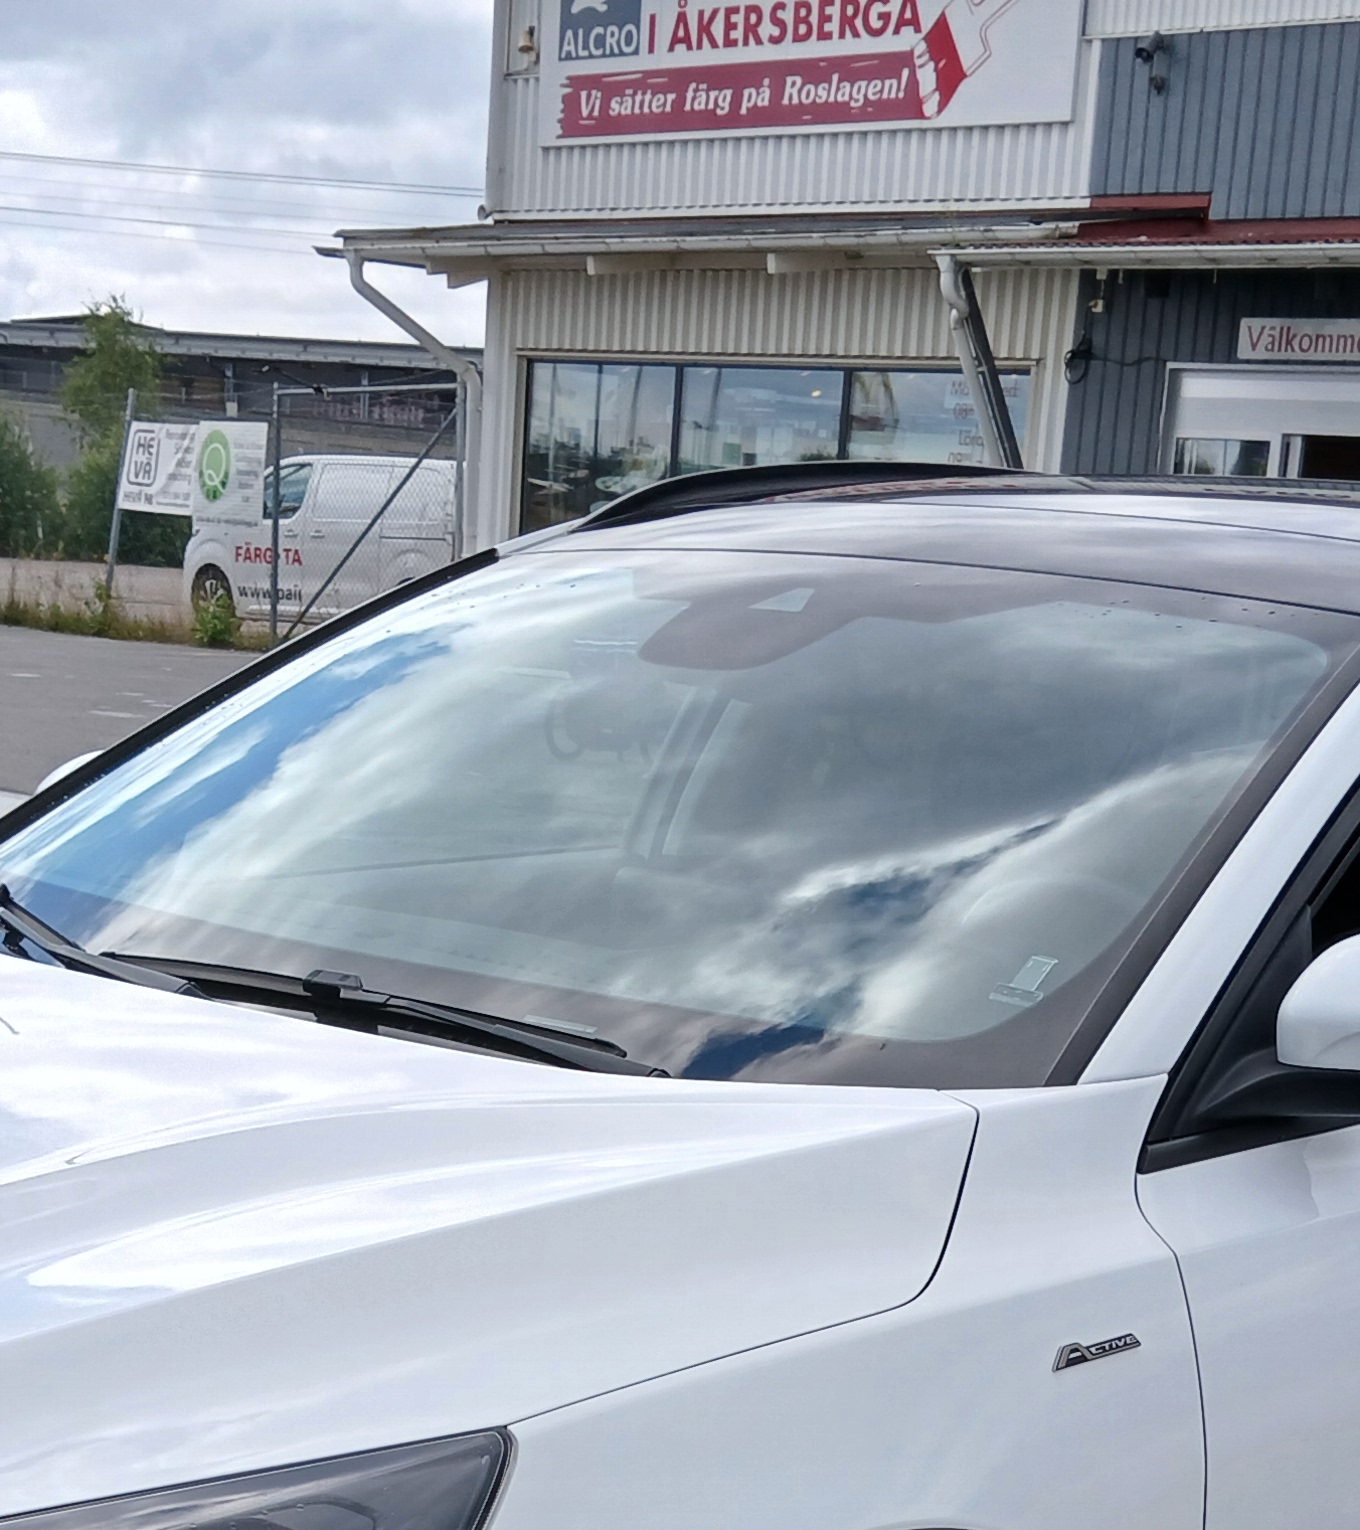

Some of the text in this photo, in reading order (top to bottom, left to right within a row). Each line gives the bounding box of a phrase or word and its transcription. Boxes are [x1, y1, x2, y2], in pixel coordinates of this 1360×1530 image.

[560, 23, 639, 59] ALCRO
[647, 0, 923, 55] I ÅKERSBERGA
[580, 67, 910, 119] Vi sätter färg på Roslagen!
